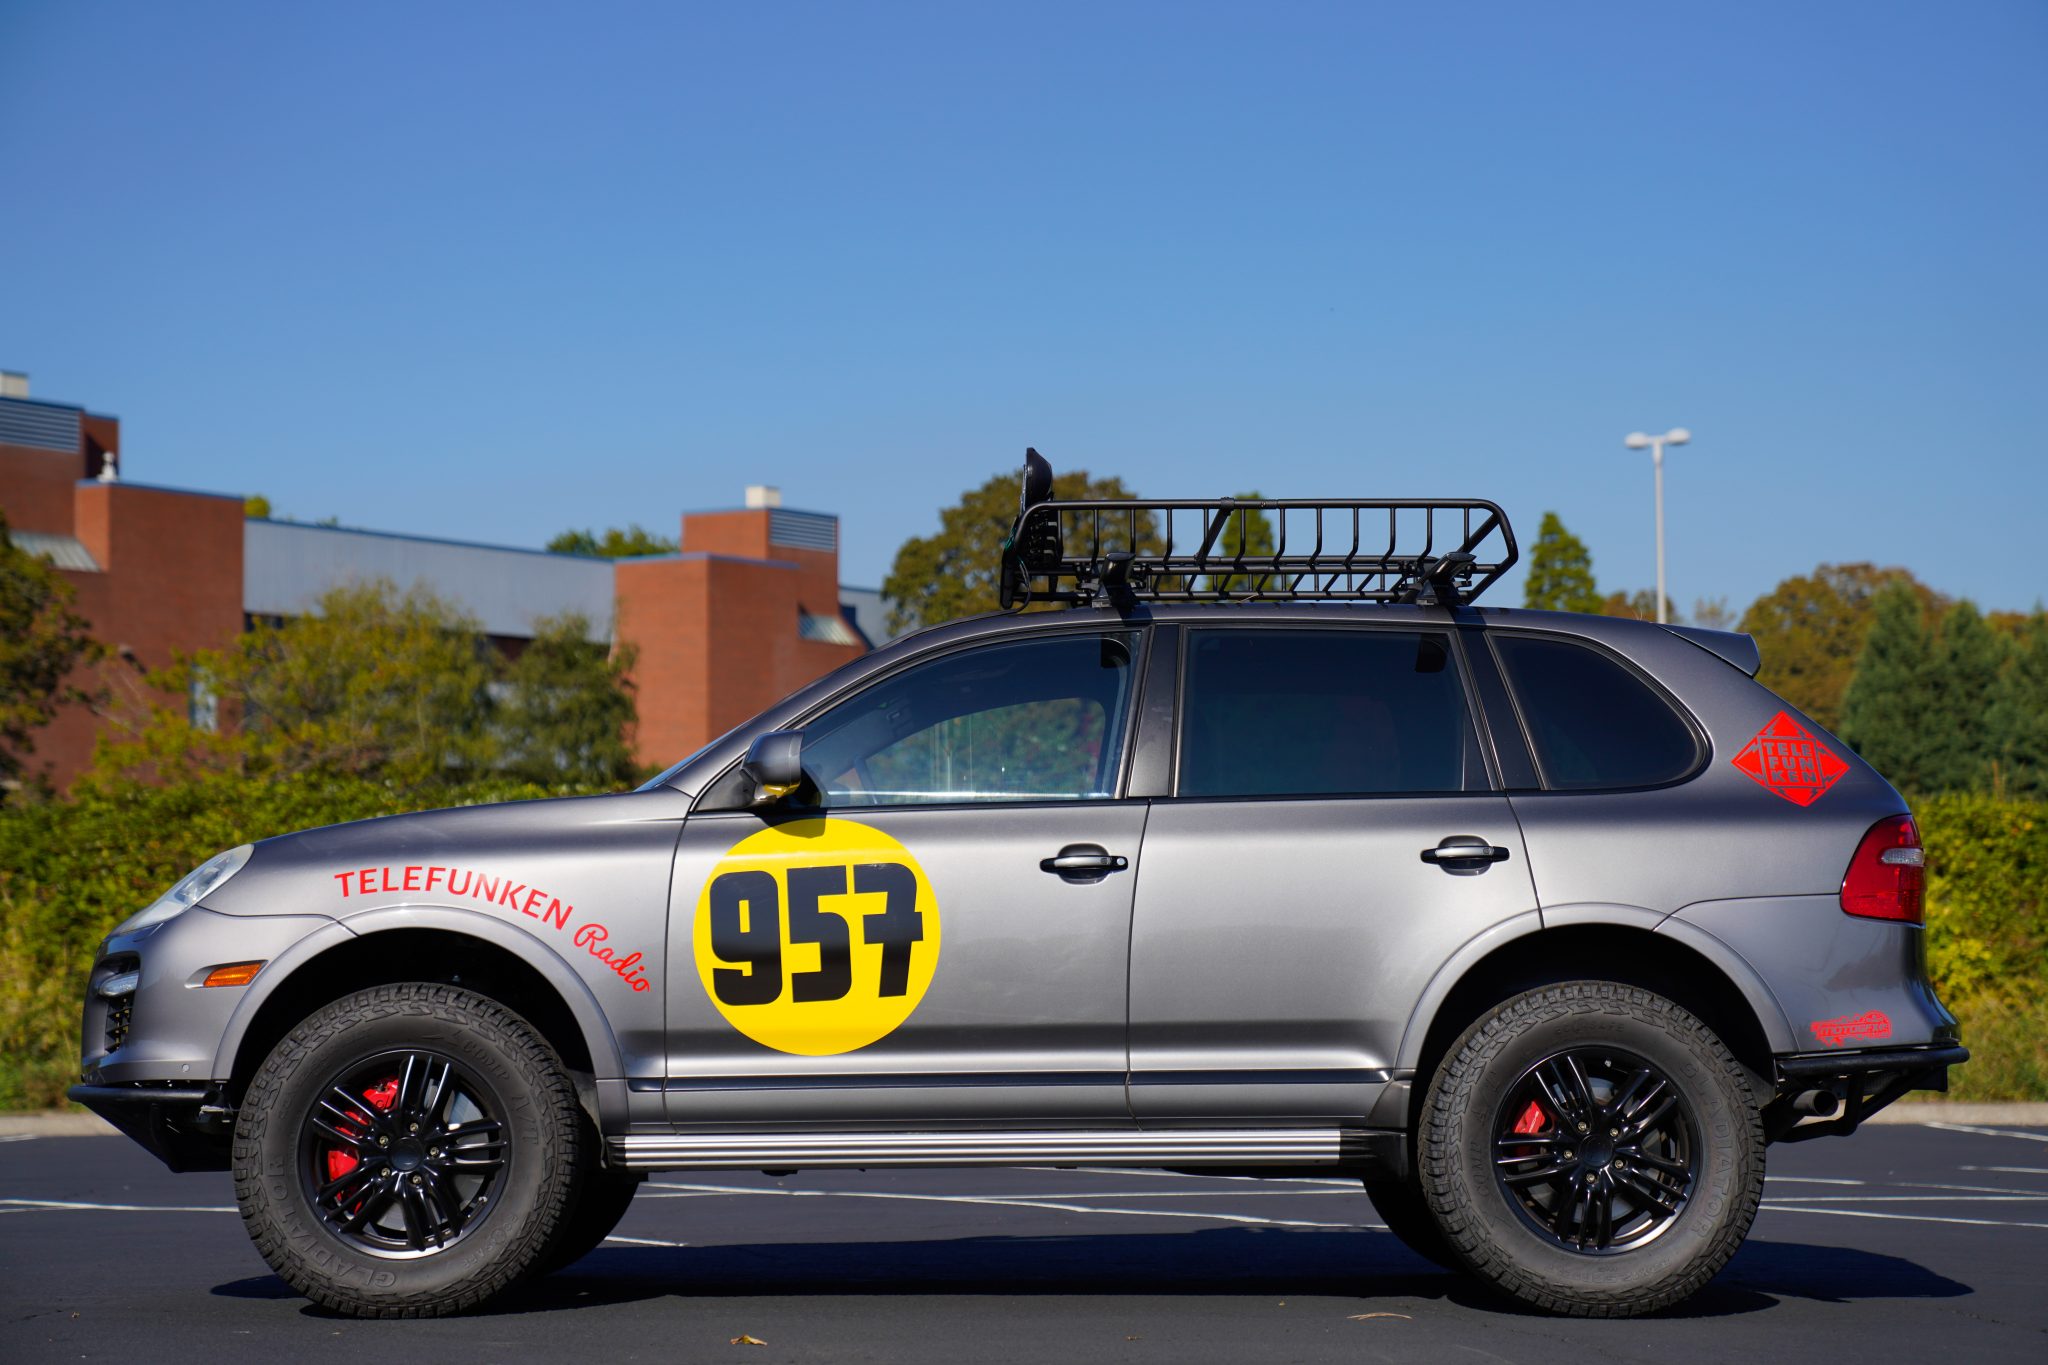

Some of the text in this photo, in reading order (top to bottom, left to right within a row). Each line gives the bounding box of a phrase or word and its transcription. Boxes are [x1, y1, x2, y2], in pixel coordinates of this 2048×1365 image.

[1764, 742, 1812, 757] TELE
[1768, 756, 1815, 770] FUN
[1770, 770, 1818, 783] KEN
[334, 866, 649, 992] TELEFUNKEN Radio
[709, 862, 924, 1006] 957
[1679, 1062, 1734, 1238] GLADIATOR
[267, 1155, 396, 1288] GLADIATOR
